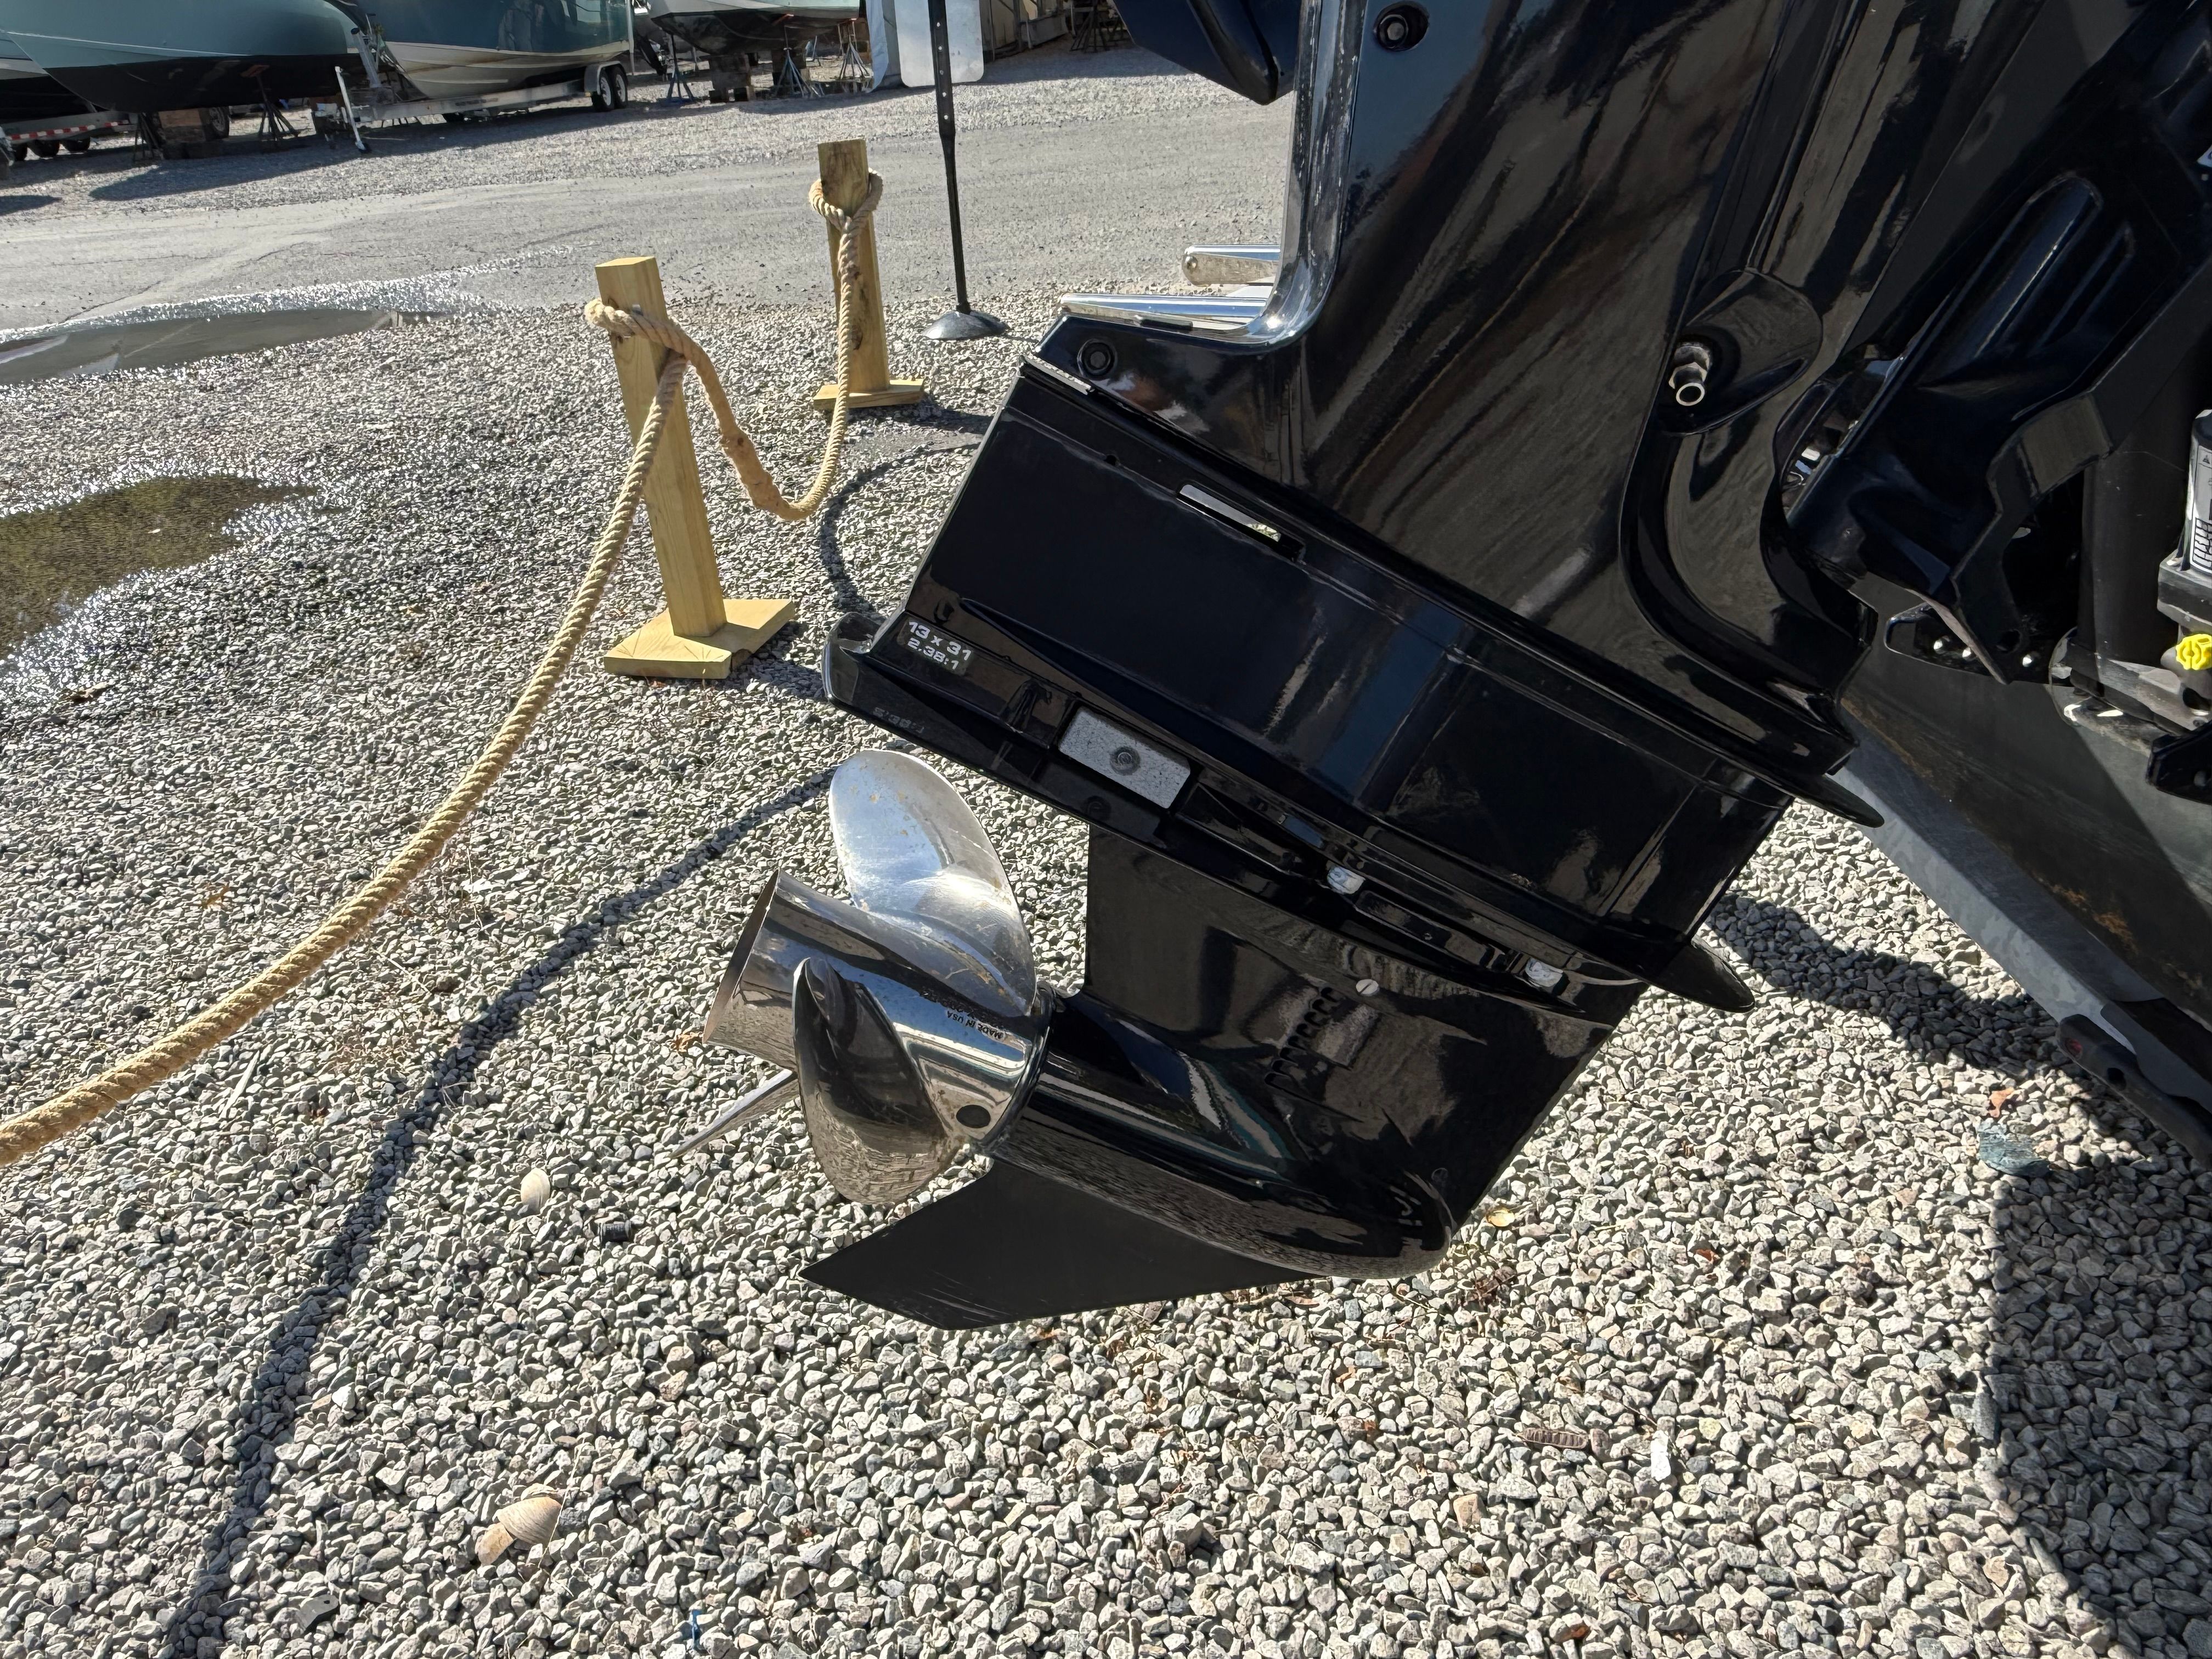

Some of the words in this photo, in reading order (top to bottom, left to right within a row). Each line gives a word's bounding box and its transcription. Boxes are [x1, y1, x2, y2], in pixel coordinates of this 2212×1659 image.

[909, 621, 931, 640] 13
[946, 641, 972, 661] 31
[907, 637, 960, 670] 2.38:1
[947, 1011, 964, 1024] USA
[965, 1019, 976, 1028] IN
[977, 1023, 1005, 1040] MADE
